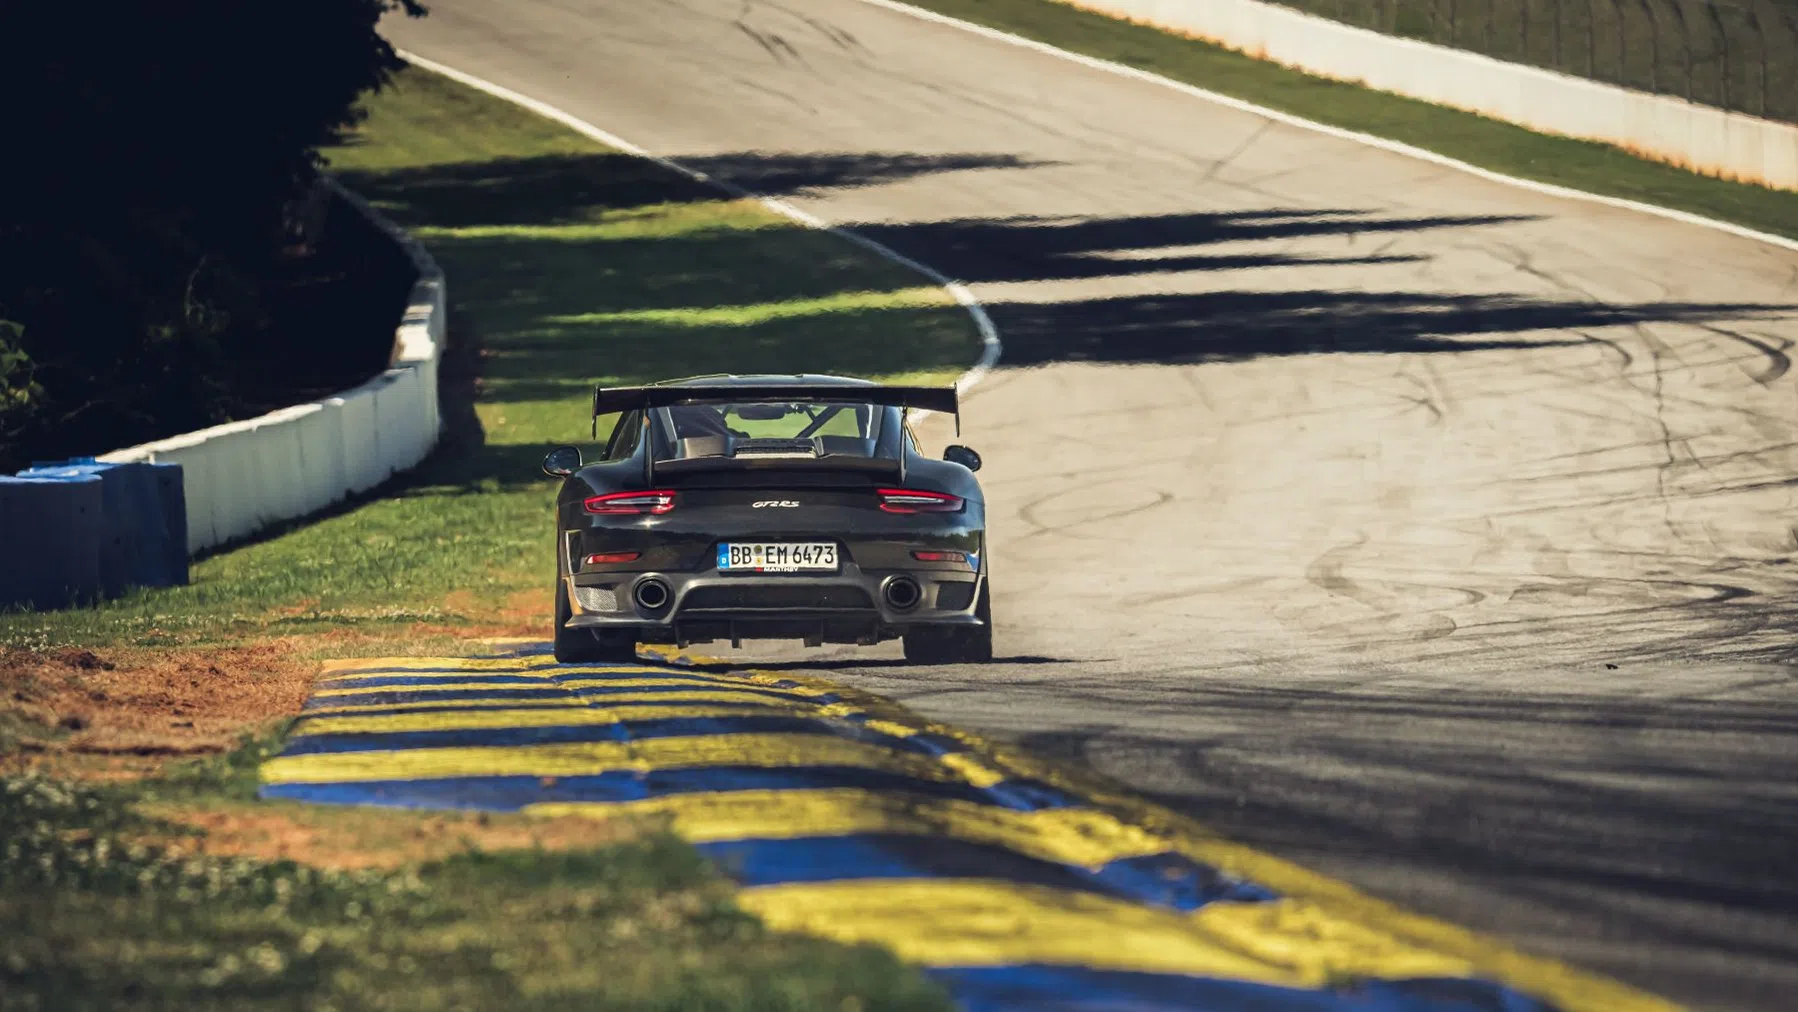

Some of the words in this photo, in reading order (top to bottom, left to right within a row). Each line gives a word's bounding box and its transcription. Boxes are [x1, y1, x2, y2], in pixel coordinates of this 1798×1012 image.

[731, 546, 752, 565] BB
[765, 546, 787, 564] EM
[792, 546, 834, 564] 6473
